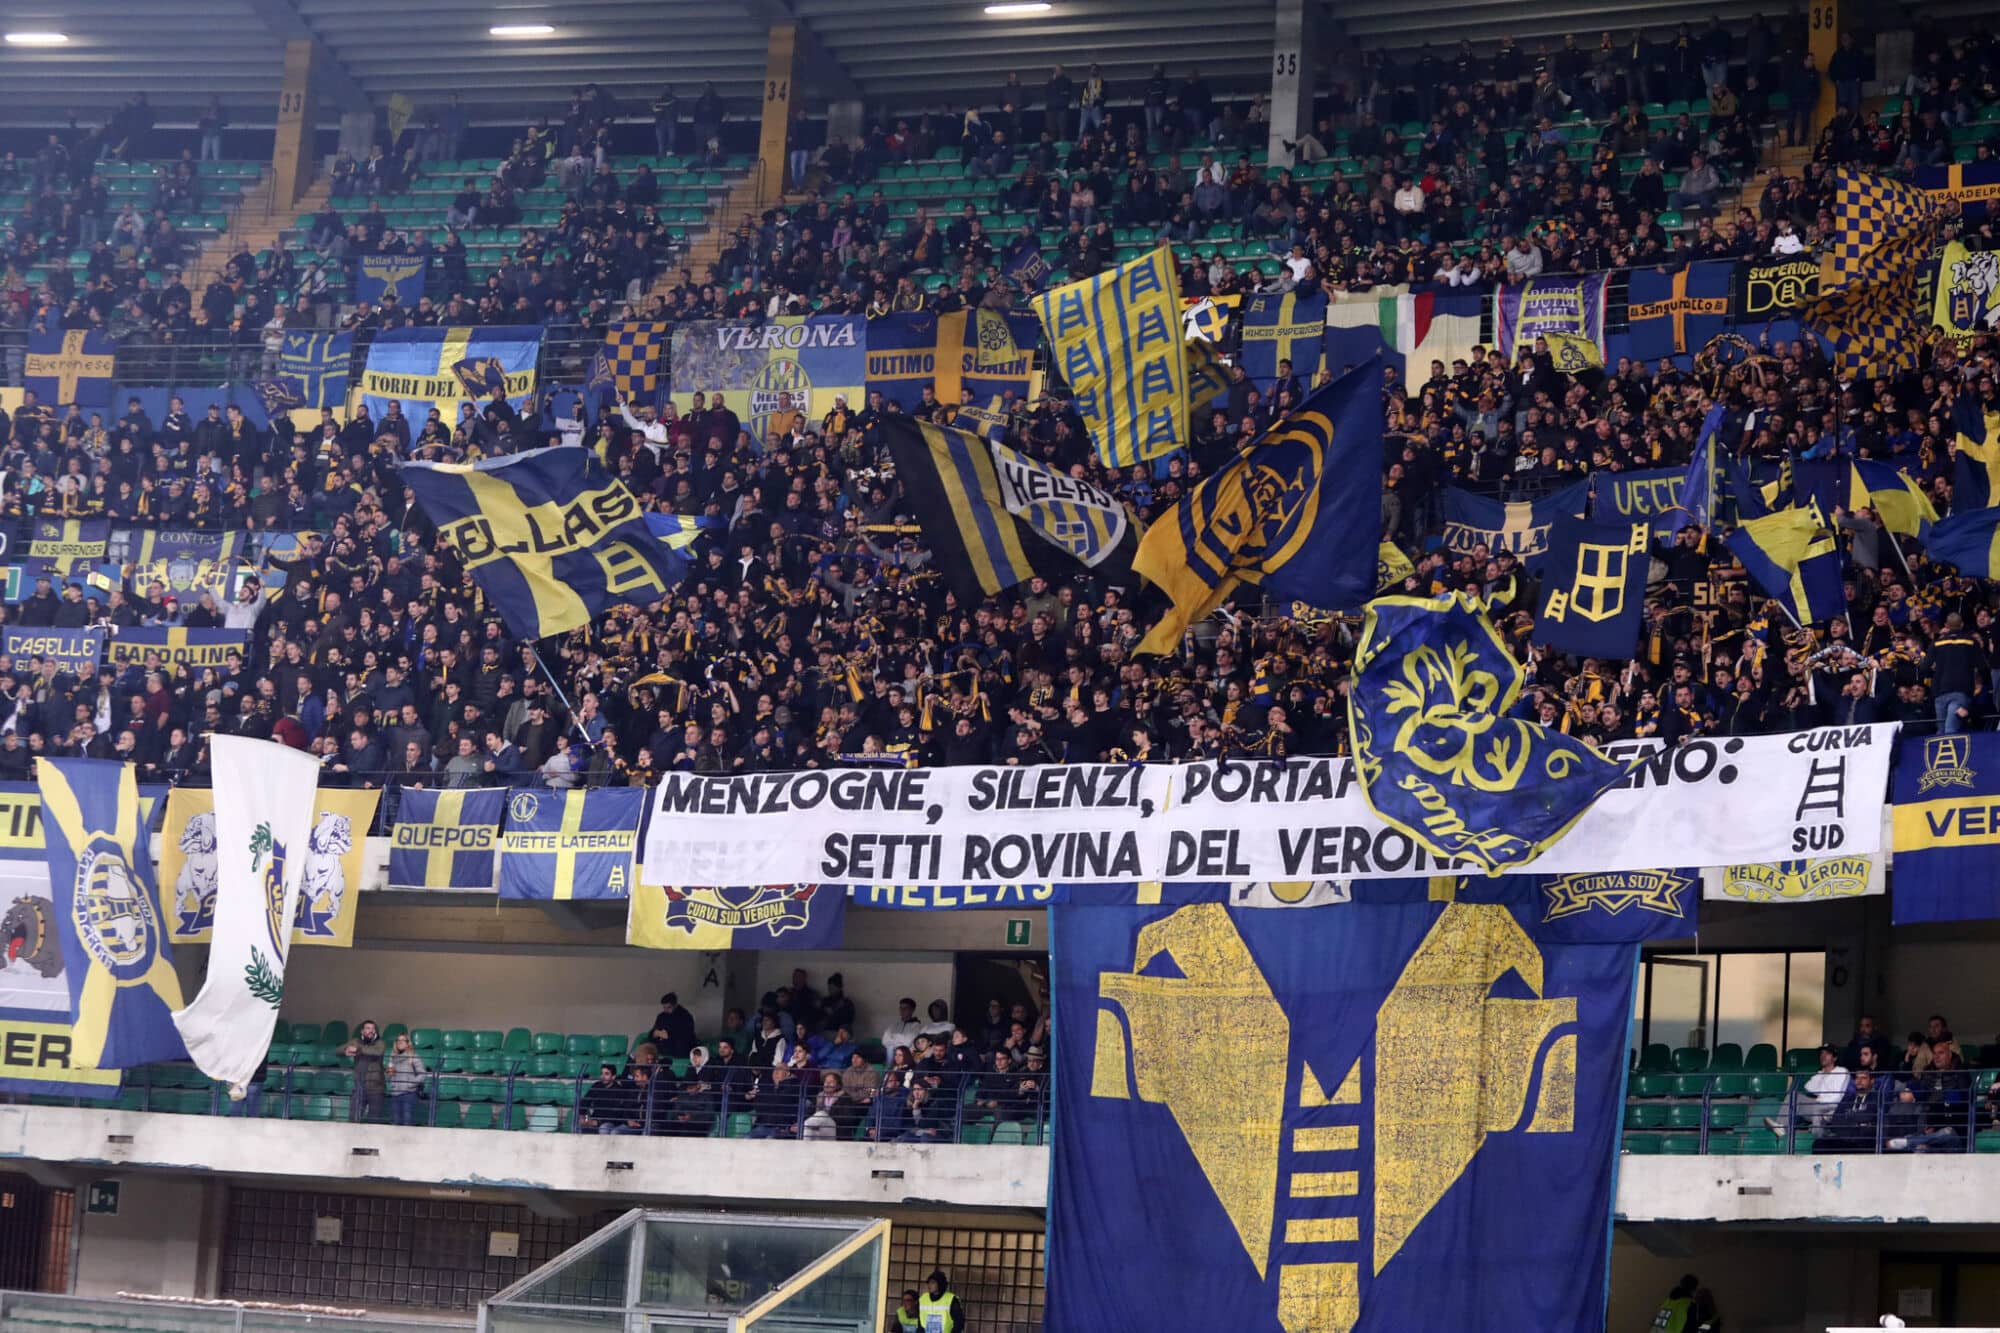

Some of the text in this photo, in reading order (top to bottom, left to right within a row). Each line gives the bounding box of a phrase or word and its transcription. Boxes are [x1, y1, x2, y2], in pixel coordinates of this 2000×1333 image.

[1813, 6, 1833, 30] 36
[1276, 53, 1296, 76] 35
[281, 92, 302, 113] 33
[767, 80, 786, 102] 34
[717, 323, 857, 351] VERONA
[869, 353, 935, 375] ULTIMO
[368, 374, 420, 396] TORRI
[424, 380, 457, 398] DEL
[1004, 462, 1112, 509] HELLAS
[34, 543, 104, 556] NO SURRENDER
[8, 636, 96, 657] CASELLE
[1787, 725, 1874, 755] CURVA
[661, 771, 943, 825] MENZOGNE,
[968, 764, 1155, 819] SILENZI,
[397, 826, 492, 847] QUEPOS
[505, 834, 631, 849] VIETTE LATERALI
[1791, 823, 1845, 854] SUD
[820, 832, 942, 880] SETTI
[962, 831, 1142, 881] ROVINA
[1165, 829, 1251, 877] DEL
[1572, 874, 1659, 894] CURVA SUD
[1729, 860, 1865, 892] HELLAS VERONA
[686, 901, 787, 924] CURVA SUD VERONA
